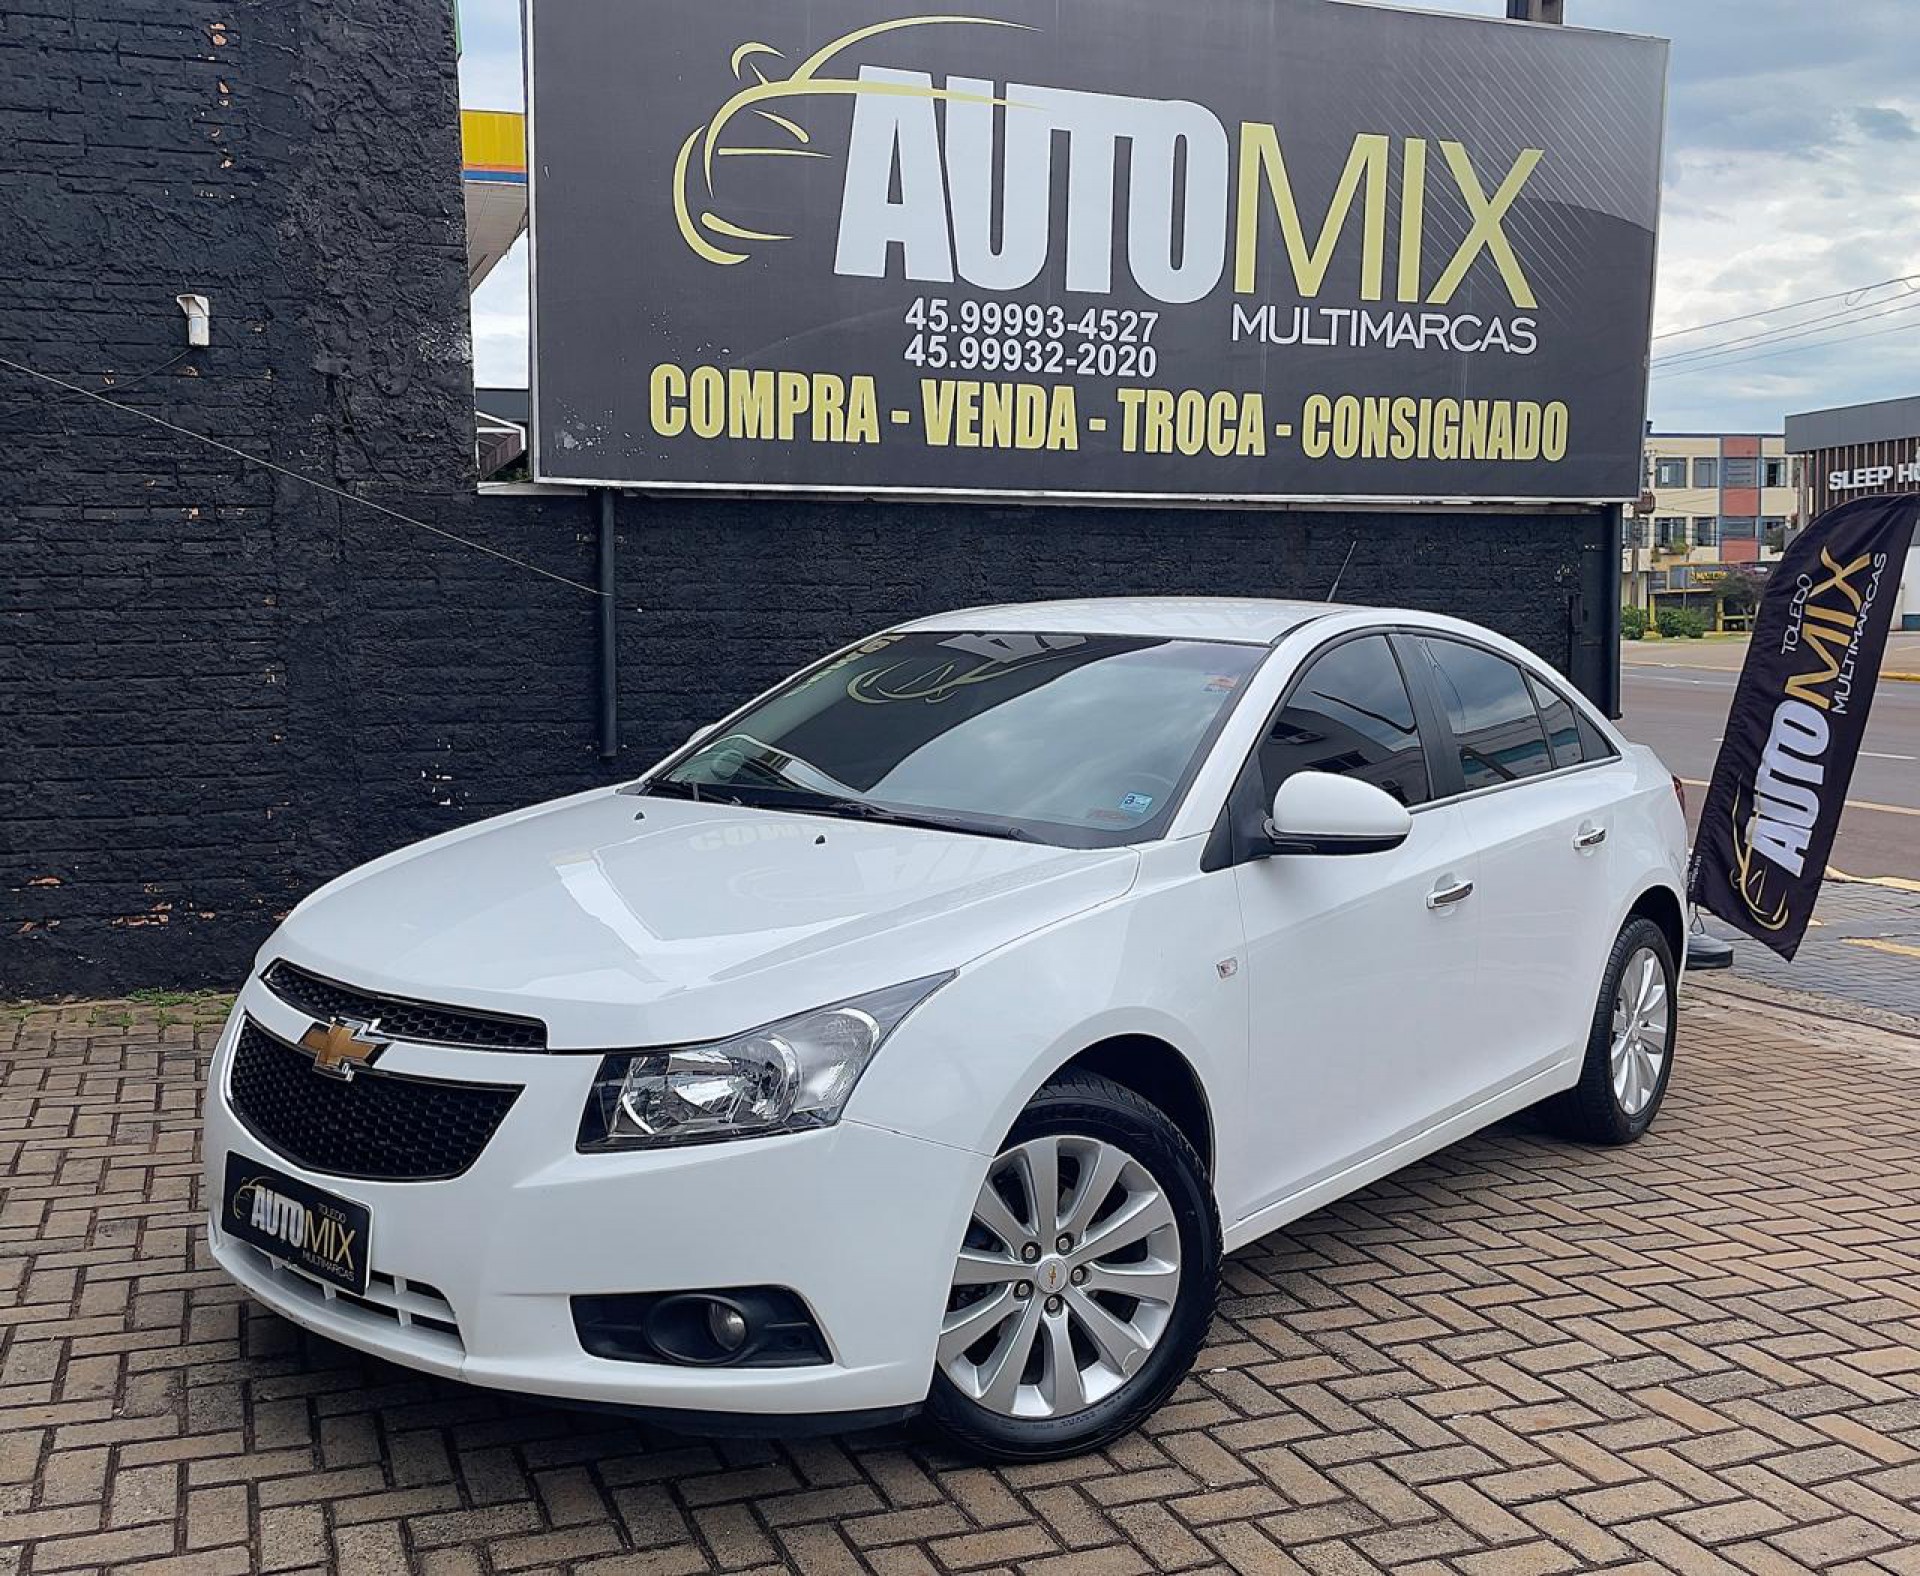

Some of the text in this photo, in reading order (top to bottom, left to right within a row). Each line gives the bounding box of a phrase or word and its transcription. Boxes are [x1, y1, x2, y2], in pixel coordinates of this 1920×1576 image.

[904, 297, 1159, 343] 45.99993-4527
[1232, 303, 1538, 355] MULTIMARCAS
[904, 333, 1157, 378] 45.99932-2020
[650, 363, 880, 444] COMPRA
[920, 378, 1079, 451] VENDA
[1117, 387, 1266, 457] TROCA
[1302, 394, 1569, 461] CONSIGNADO
[1829, 465, 1894, 490] SLEEP
[1781, 573, 1813, 655] TOLEDO
[1831, 552, 1887, 715] MULTIMARCAS
